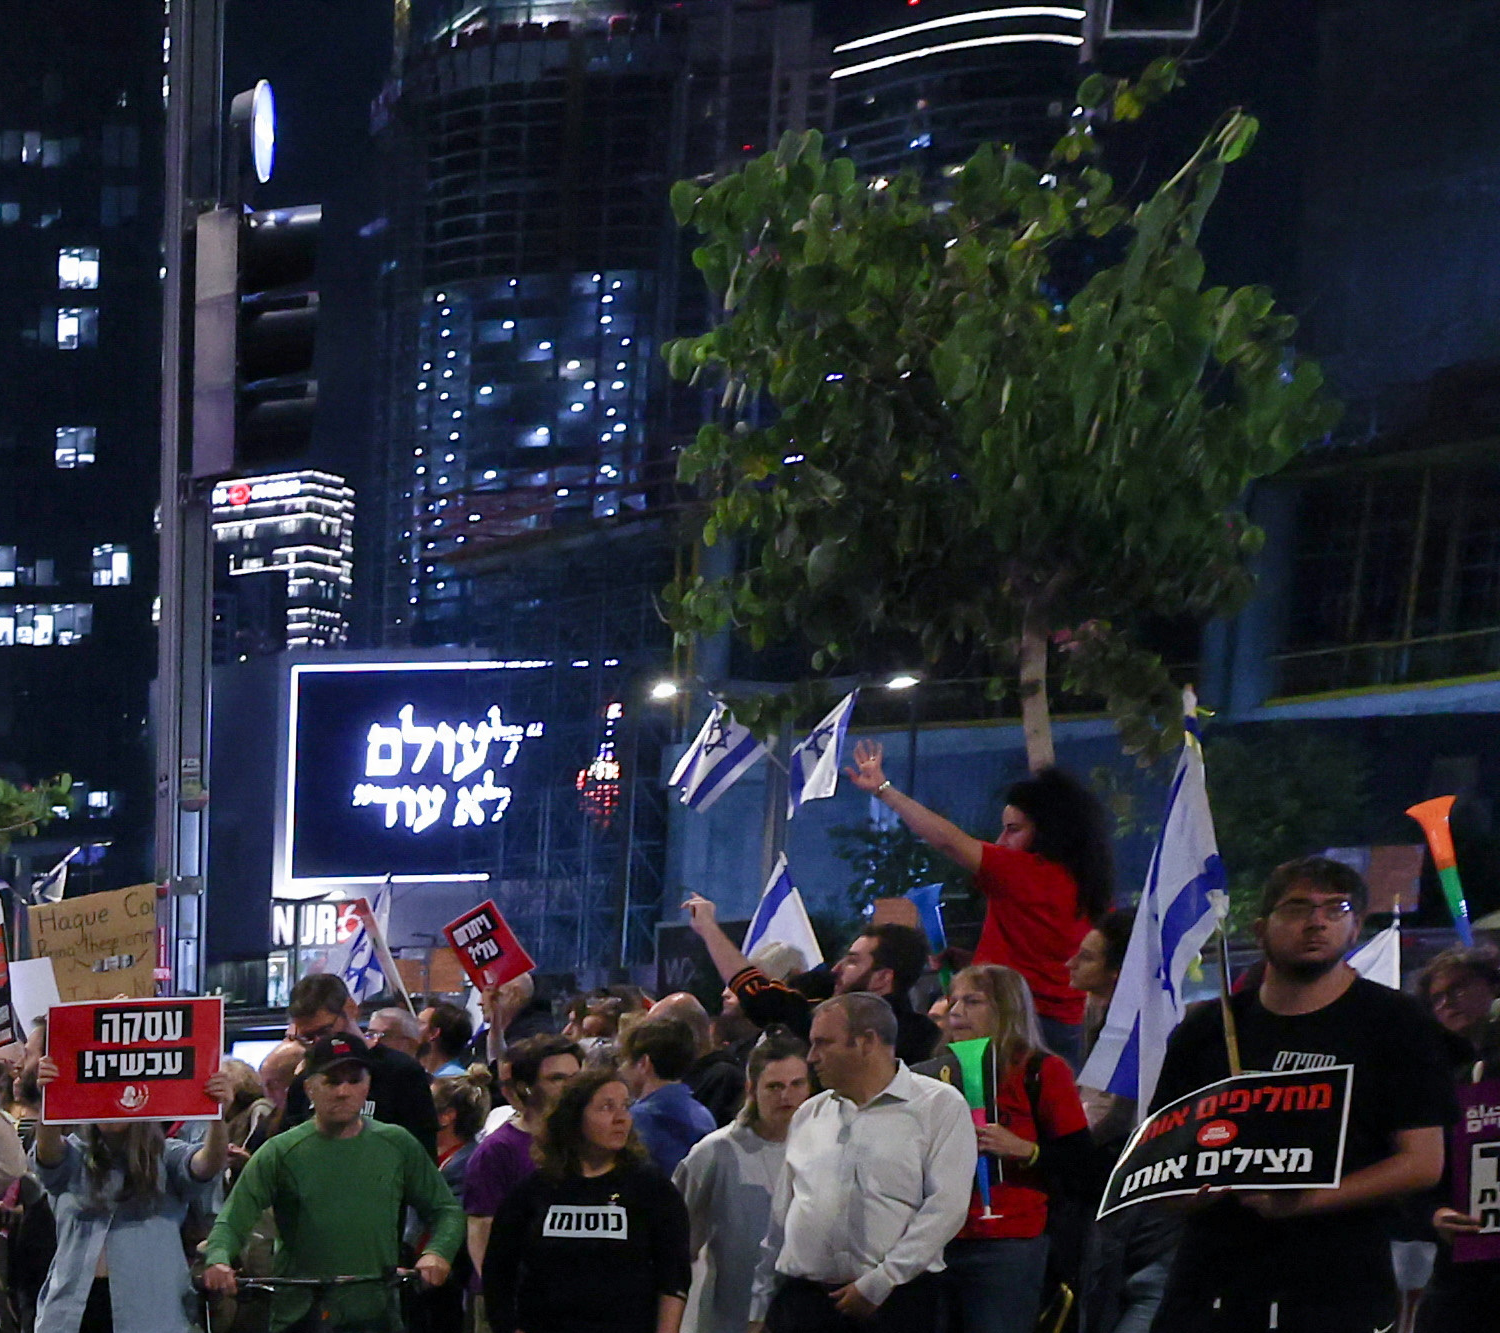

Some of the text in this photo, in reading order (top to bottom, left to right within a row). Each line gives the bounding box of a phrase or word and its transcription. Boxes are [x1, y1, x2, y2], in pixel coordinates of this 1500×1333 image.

[453, 769, 511, 827] לא
[101, 1010, 184, 1046] עסקה
[84, 1051, 183, 1078] עכשיו!
[1196, 1083, 1333, 1120] מחליפים
[1196, 1147, 1313, 1177] מצילים
